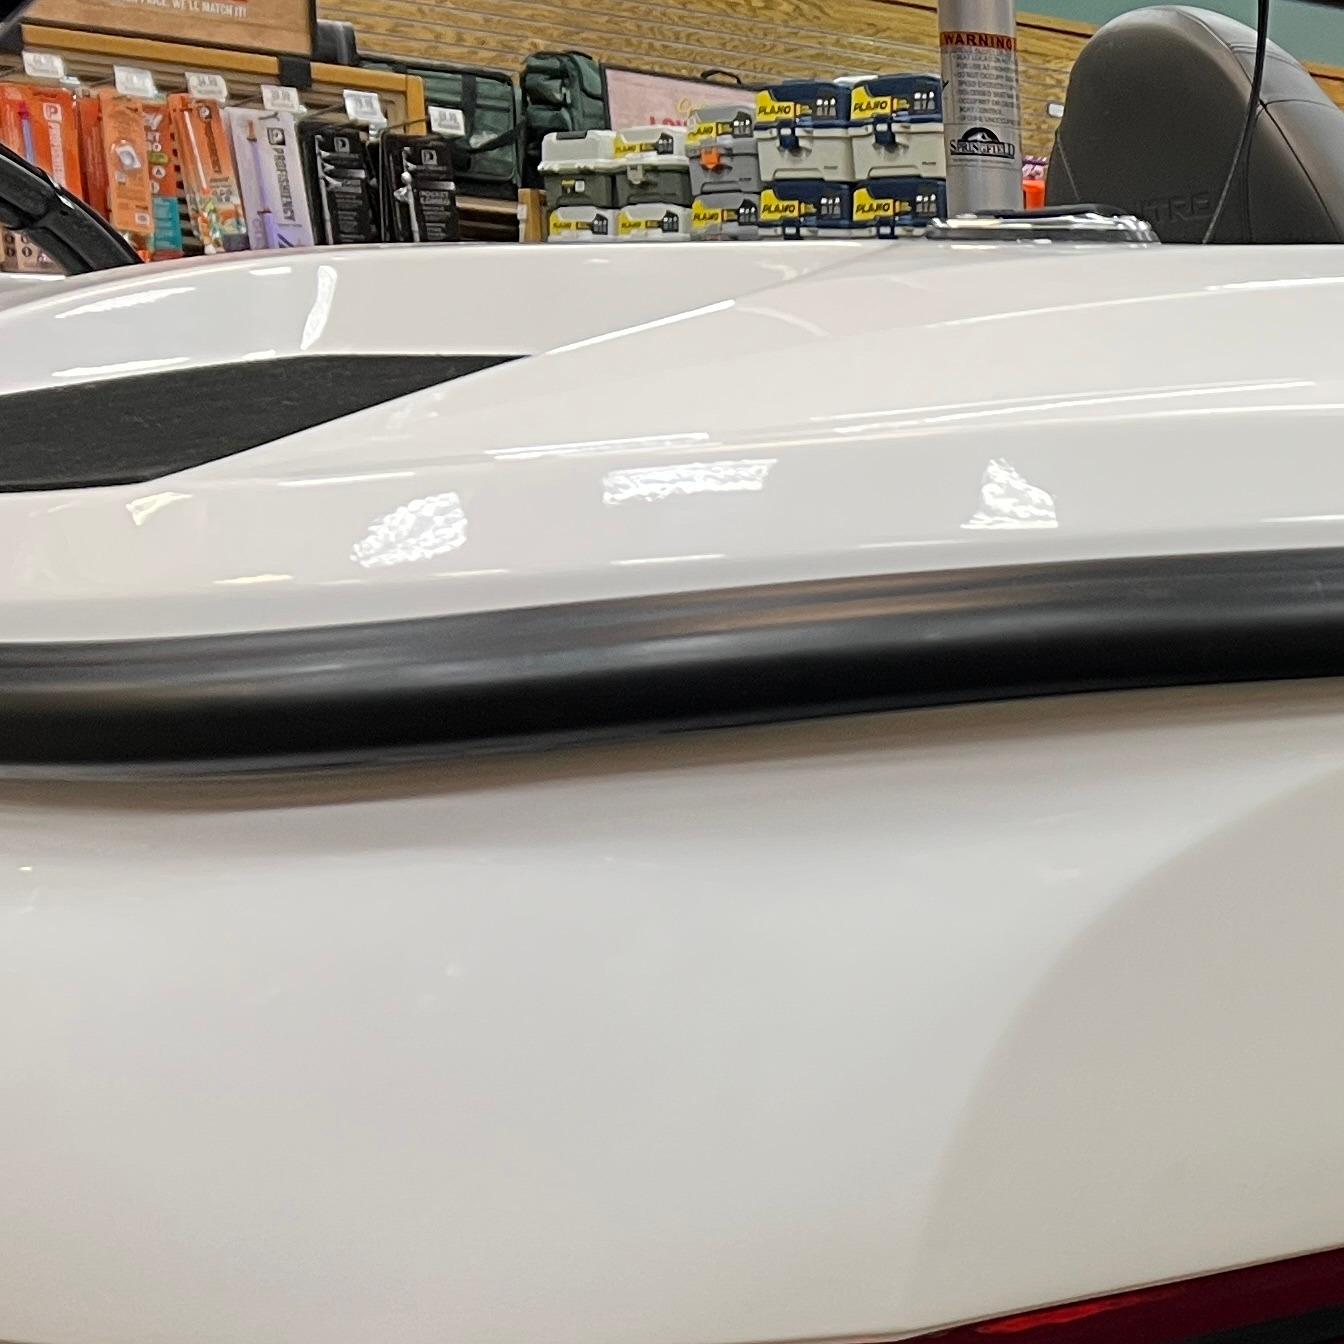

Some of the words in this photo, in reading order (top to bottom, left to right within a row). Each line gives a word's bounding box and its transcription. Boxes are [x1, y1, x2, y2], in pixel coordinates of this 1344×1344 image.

[202, 2, 232, 17] MATCH
[943, 33, 1014, 49] WARNING
[758, 105, 791, 116] PLANO
[853, 100, 889, 113] PLANO
[950, 140, 1015, 158] SPRINGFIELD
[762, 204, 796, 214] PLANO
[855, 203, 891, 214] PLANO
